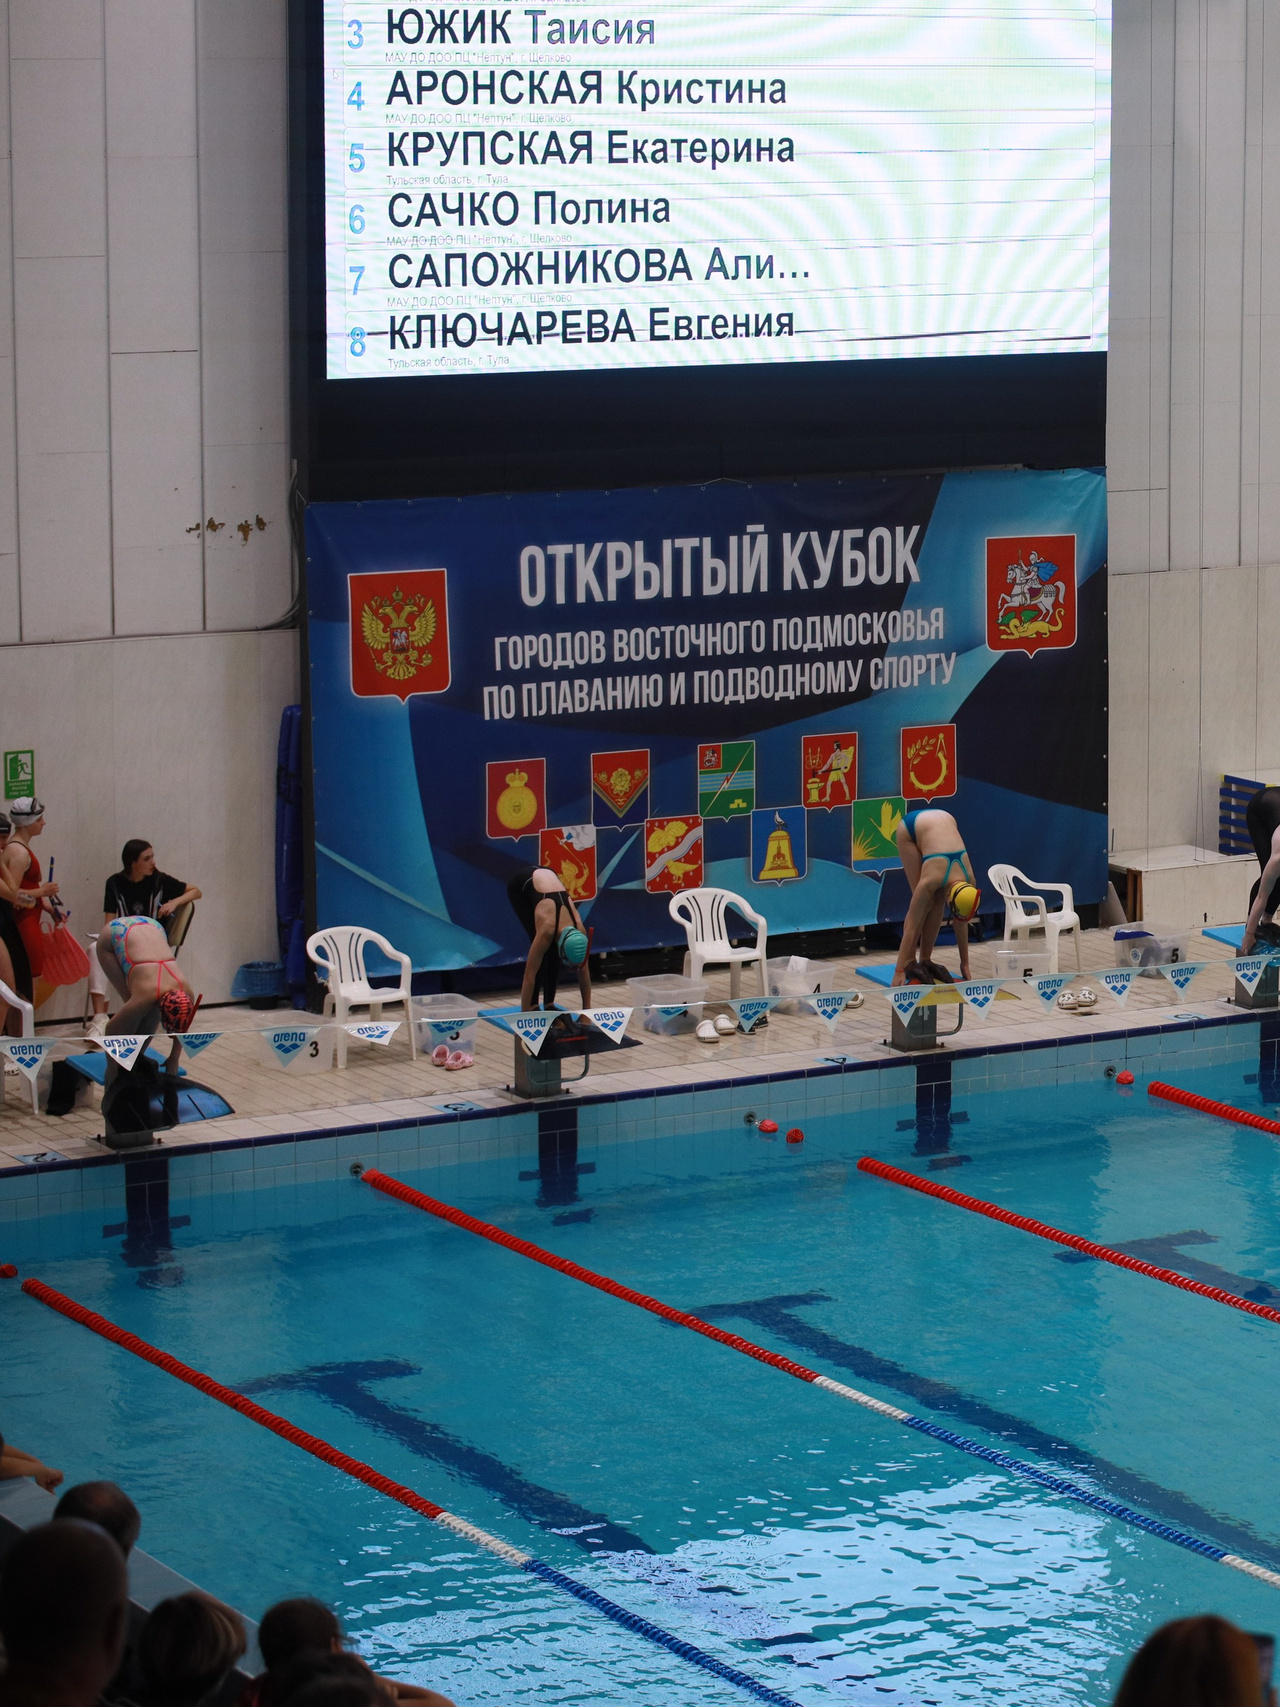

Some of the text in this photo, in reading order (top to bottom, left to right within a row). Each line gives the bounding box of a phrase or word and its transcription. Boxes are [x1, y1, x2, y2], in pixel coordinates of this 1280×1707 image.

[347, 8, 655, 49] 3 ЮЖИК Таисия
[385, 53, 408, 63] МАУ
[347, 69, 787, 112] 4 АРОНСКАЯ Кристина
[386, 114, 408, 124] МАУ
[349, 130, 795, 172] 5 КРУПСКАЯ Екатерина
[387, 175, 430, 187] Тульская
[486, 174, 509, 186] Тула
[349, 190, 670, 234] 6 САЧКО Полина
[387, 236, 408, 246] МАУ
[349, 247, 810, 296] 7 САПОЖНИКОВА Али...
[387, 297, 409, 307] МАУ
[350, 307, 794, 357] 8 КЛЮЧАРЕВА Евгения
[388, 358, 432, 370] Тульская
[487, 355, 510, 367] Тула
[519, 524, 921, 607] ОТКРЫТЫЙ КУБОК
[494, 607, 944, 671] ГОРОДОВ ВОСТОЧНОГО ПОДМОСКОВЬЯ
[483, 652, 957, 721] ПО ПЛАВАНИЮ И ПОДВОДНОМУ СПОРТУ
[1171, 948, 1179, 963] 5
[1170, 967, 1196, 978] arena
[1236, 961, 1262, 972] arena
[1037, 978, 1063, 990] arena
[1105, 973, 1131, 984] arena
[965, 985, 994, 996] arena
[817, 996, 844, 1008] arena
[893, 991, 920, 1003] arena
[740, 1001, 768, 1013] arena
[594, 1010, 625, 1022] arena
[517, 1017, 546, 1029] arena
[103, 1037, 138, 1049] arena
[273, 1031, 306, 1043] arena
[10, 1044, 43, 1056] arena
[309, 1041, 320, 1057] 3
